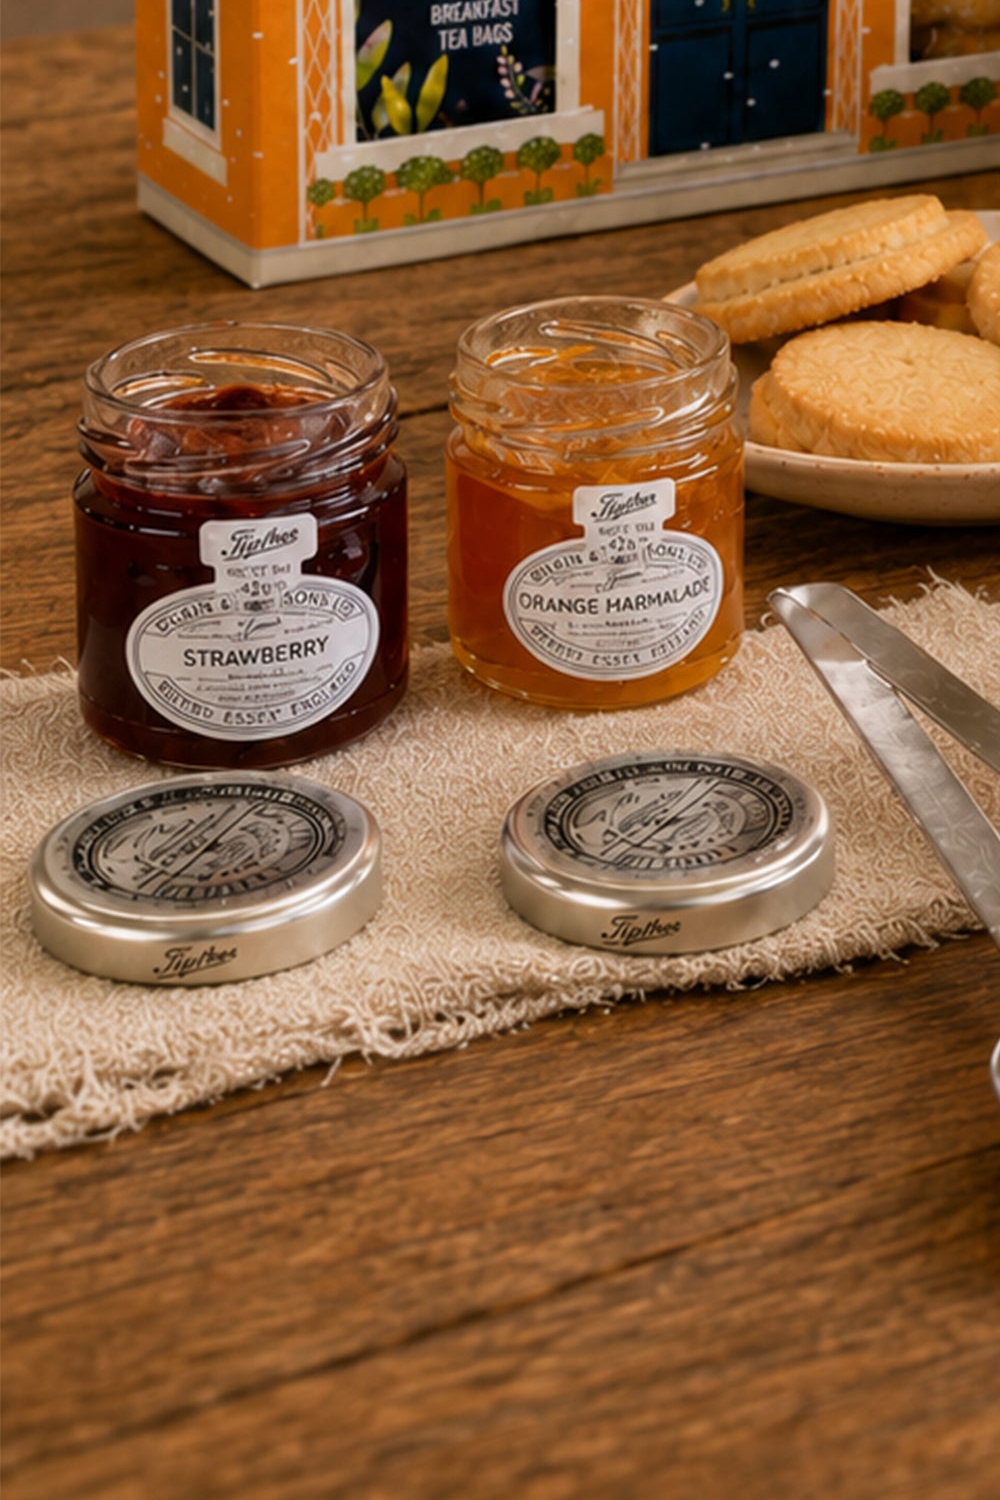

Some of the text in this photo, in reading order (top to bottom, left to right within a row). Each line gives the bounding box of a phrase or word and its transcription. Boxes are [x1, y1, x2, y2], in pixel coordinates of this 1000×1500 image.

[438, 22, 514, 51] TEA BAGS
[519, 575, 711, 615] ORANGE MARMALADE
[183, 635, 330, 668] STRAWBERRY
